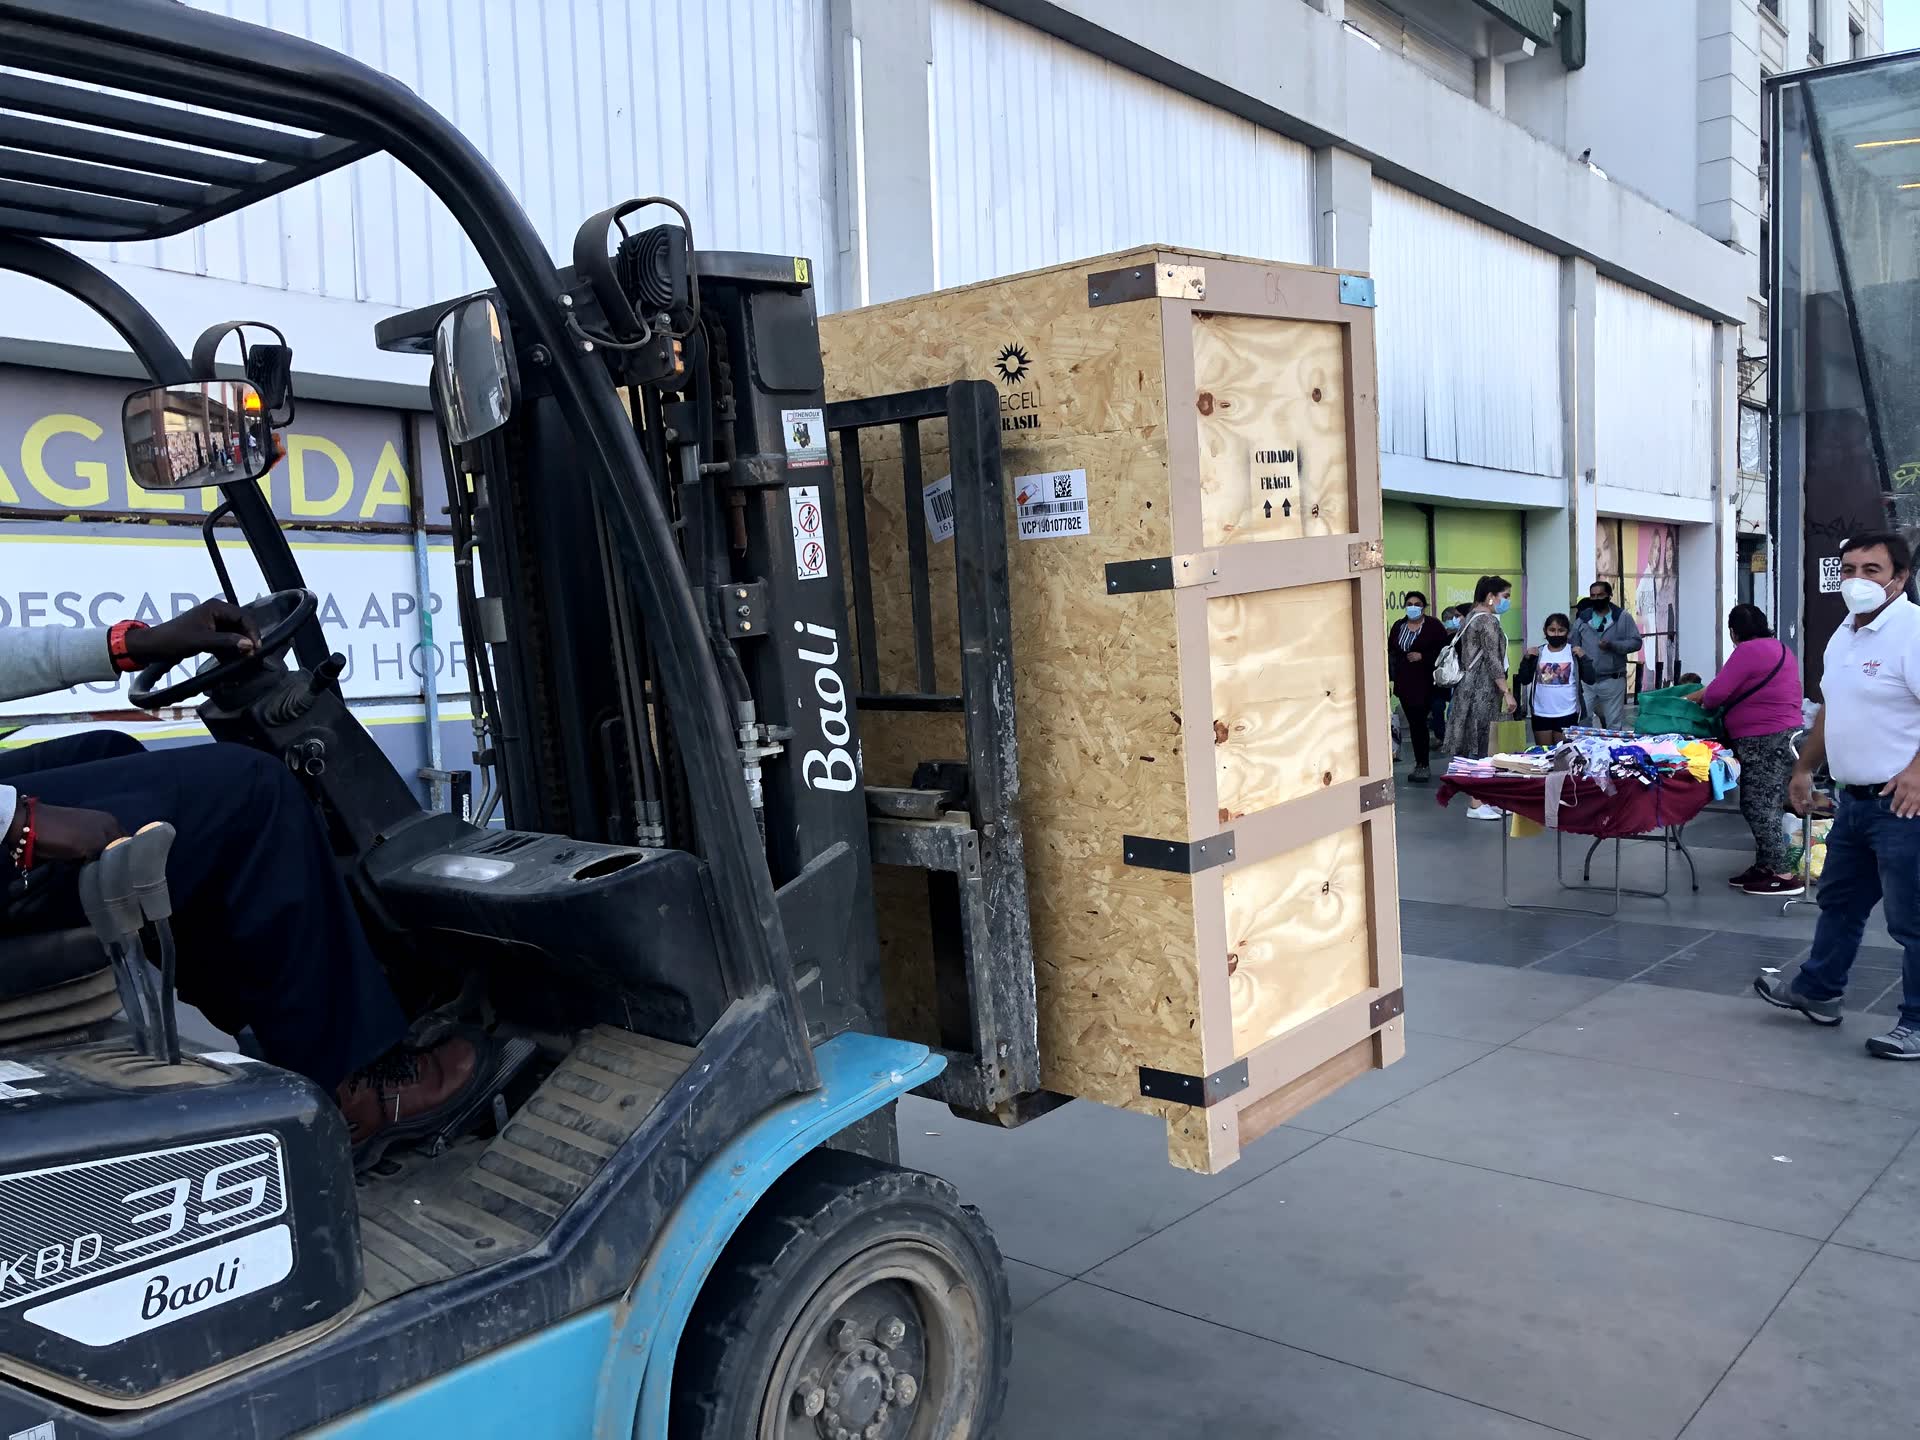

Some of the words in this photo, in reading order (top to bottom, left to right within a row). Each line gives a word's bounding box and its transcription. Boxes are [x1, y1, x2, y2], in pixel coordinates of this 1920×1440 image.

[1000, 391, 1046, 411] ECELL
[1001, 414, 1041, 431] RASIL
[1255, 449, 1295, 464] CUIDADO
[938, 520, 954, 534] 161
[1822, 558, 1841, 567] CO
[1823, 567, 1841, 577] VEH
[1822, 581, 1841, 591] +569
[794, 620, 858, 793] Baoli
[0, 1232, 103, 1291] KBD
[141, 1257, 241, 1320] Baoli
